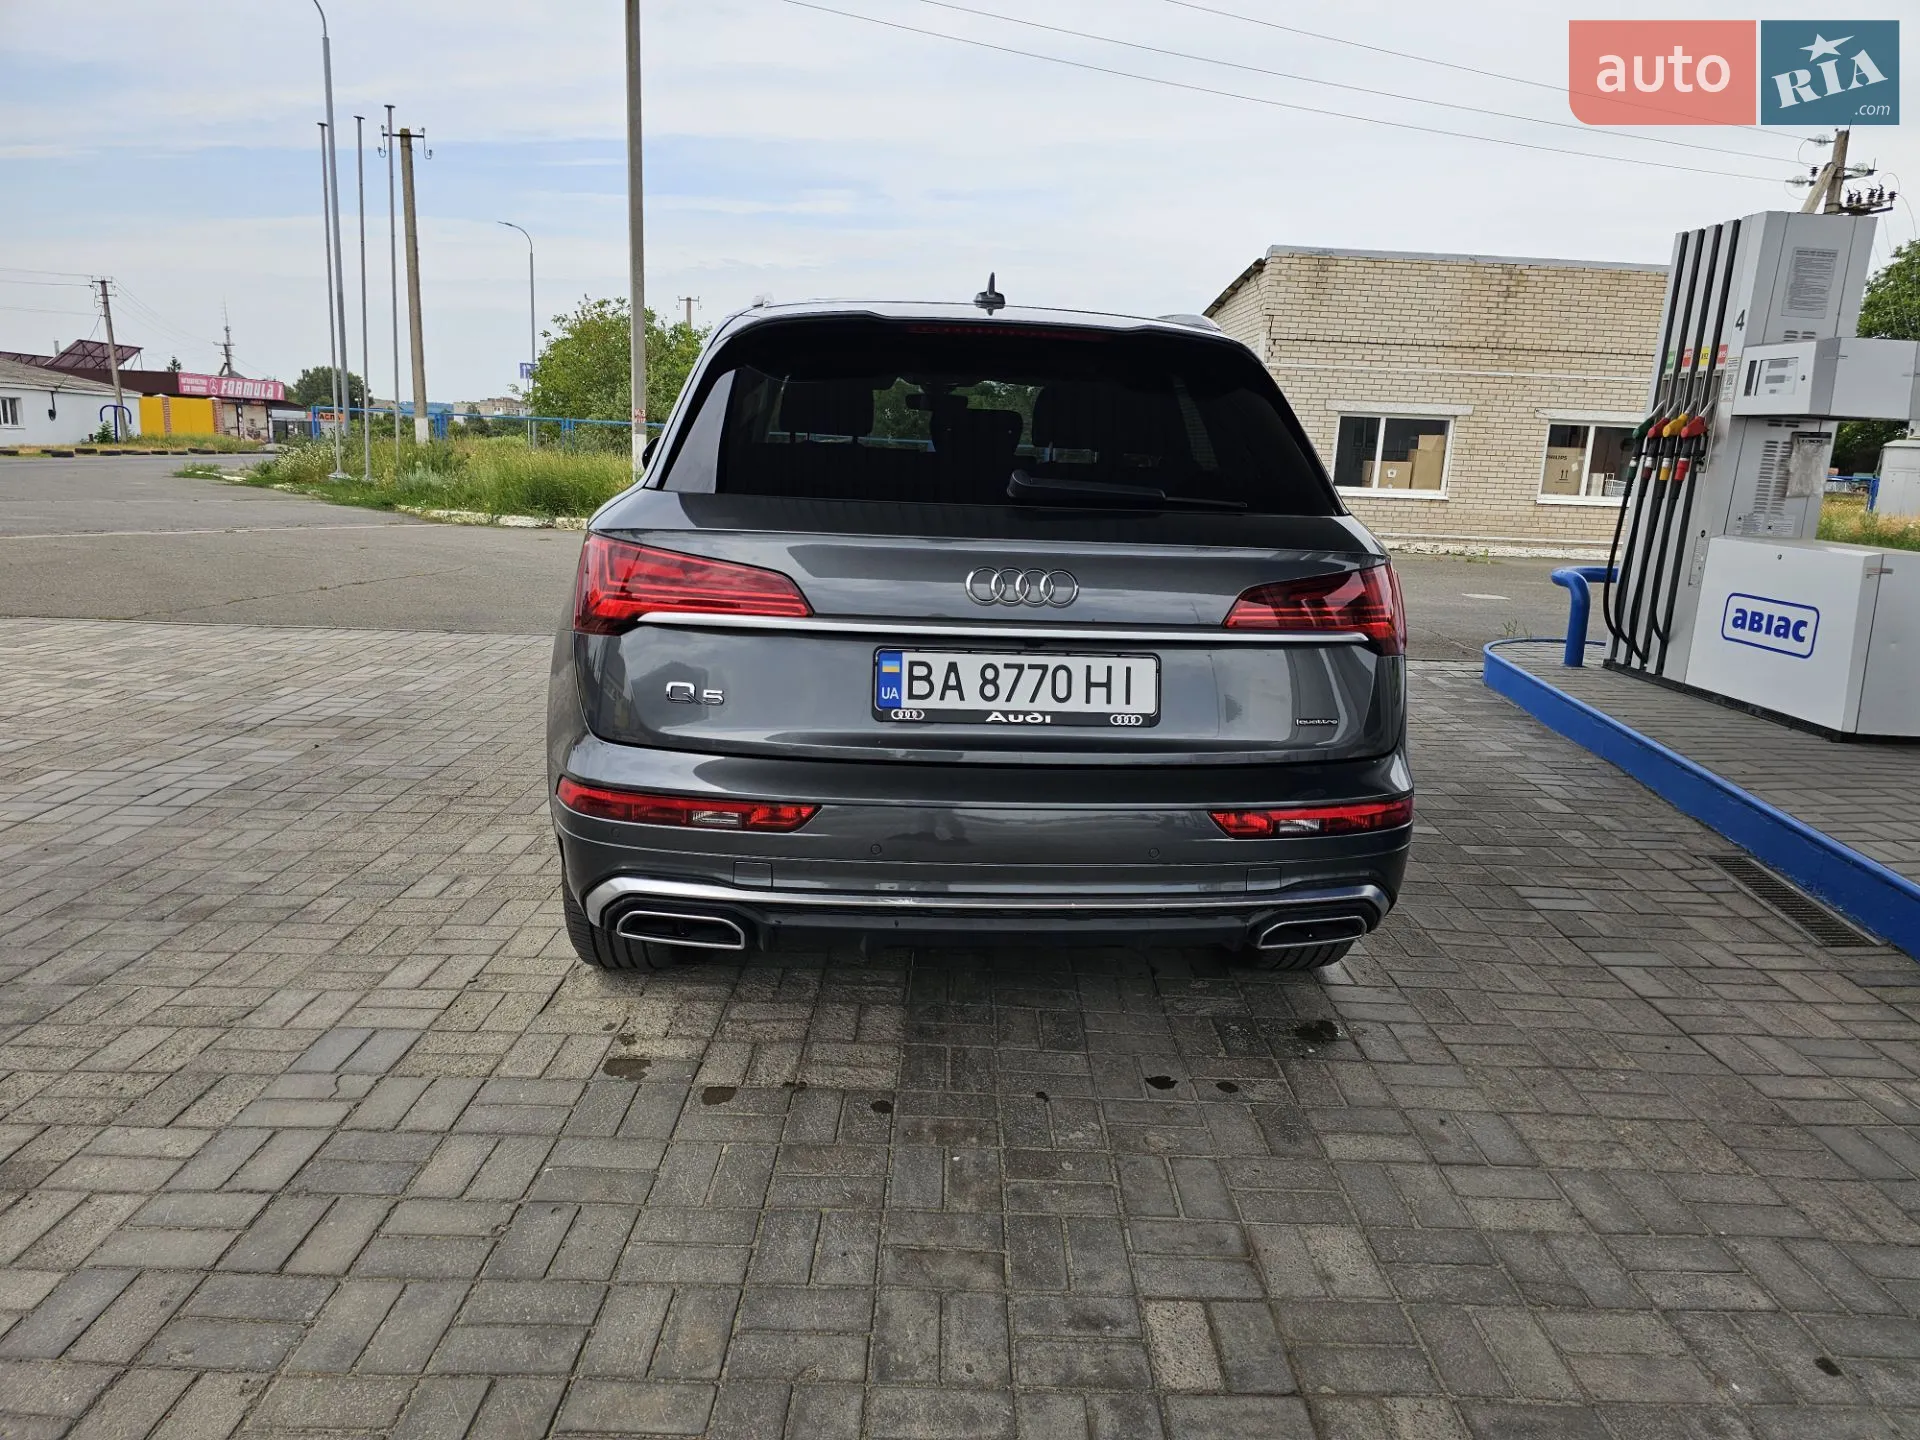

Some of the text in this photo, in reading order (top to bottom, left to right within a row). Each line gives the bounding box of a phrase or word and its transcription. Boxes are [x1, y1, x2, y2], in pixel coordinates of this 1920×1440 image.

[1735, 309, 1745, 331] 4
[220, 380, 273, 398] FORMULA
[907, 660, 1132, 705] BA 8770 HI
[666, 681, 724, 705] Q5
[881, 687, 899, 700] UA
[985, 711, 1052, 725] Audi
